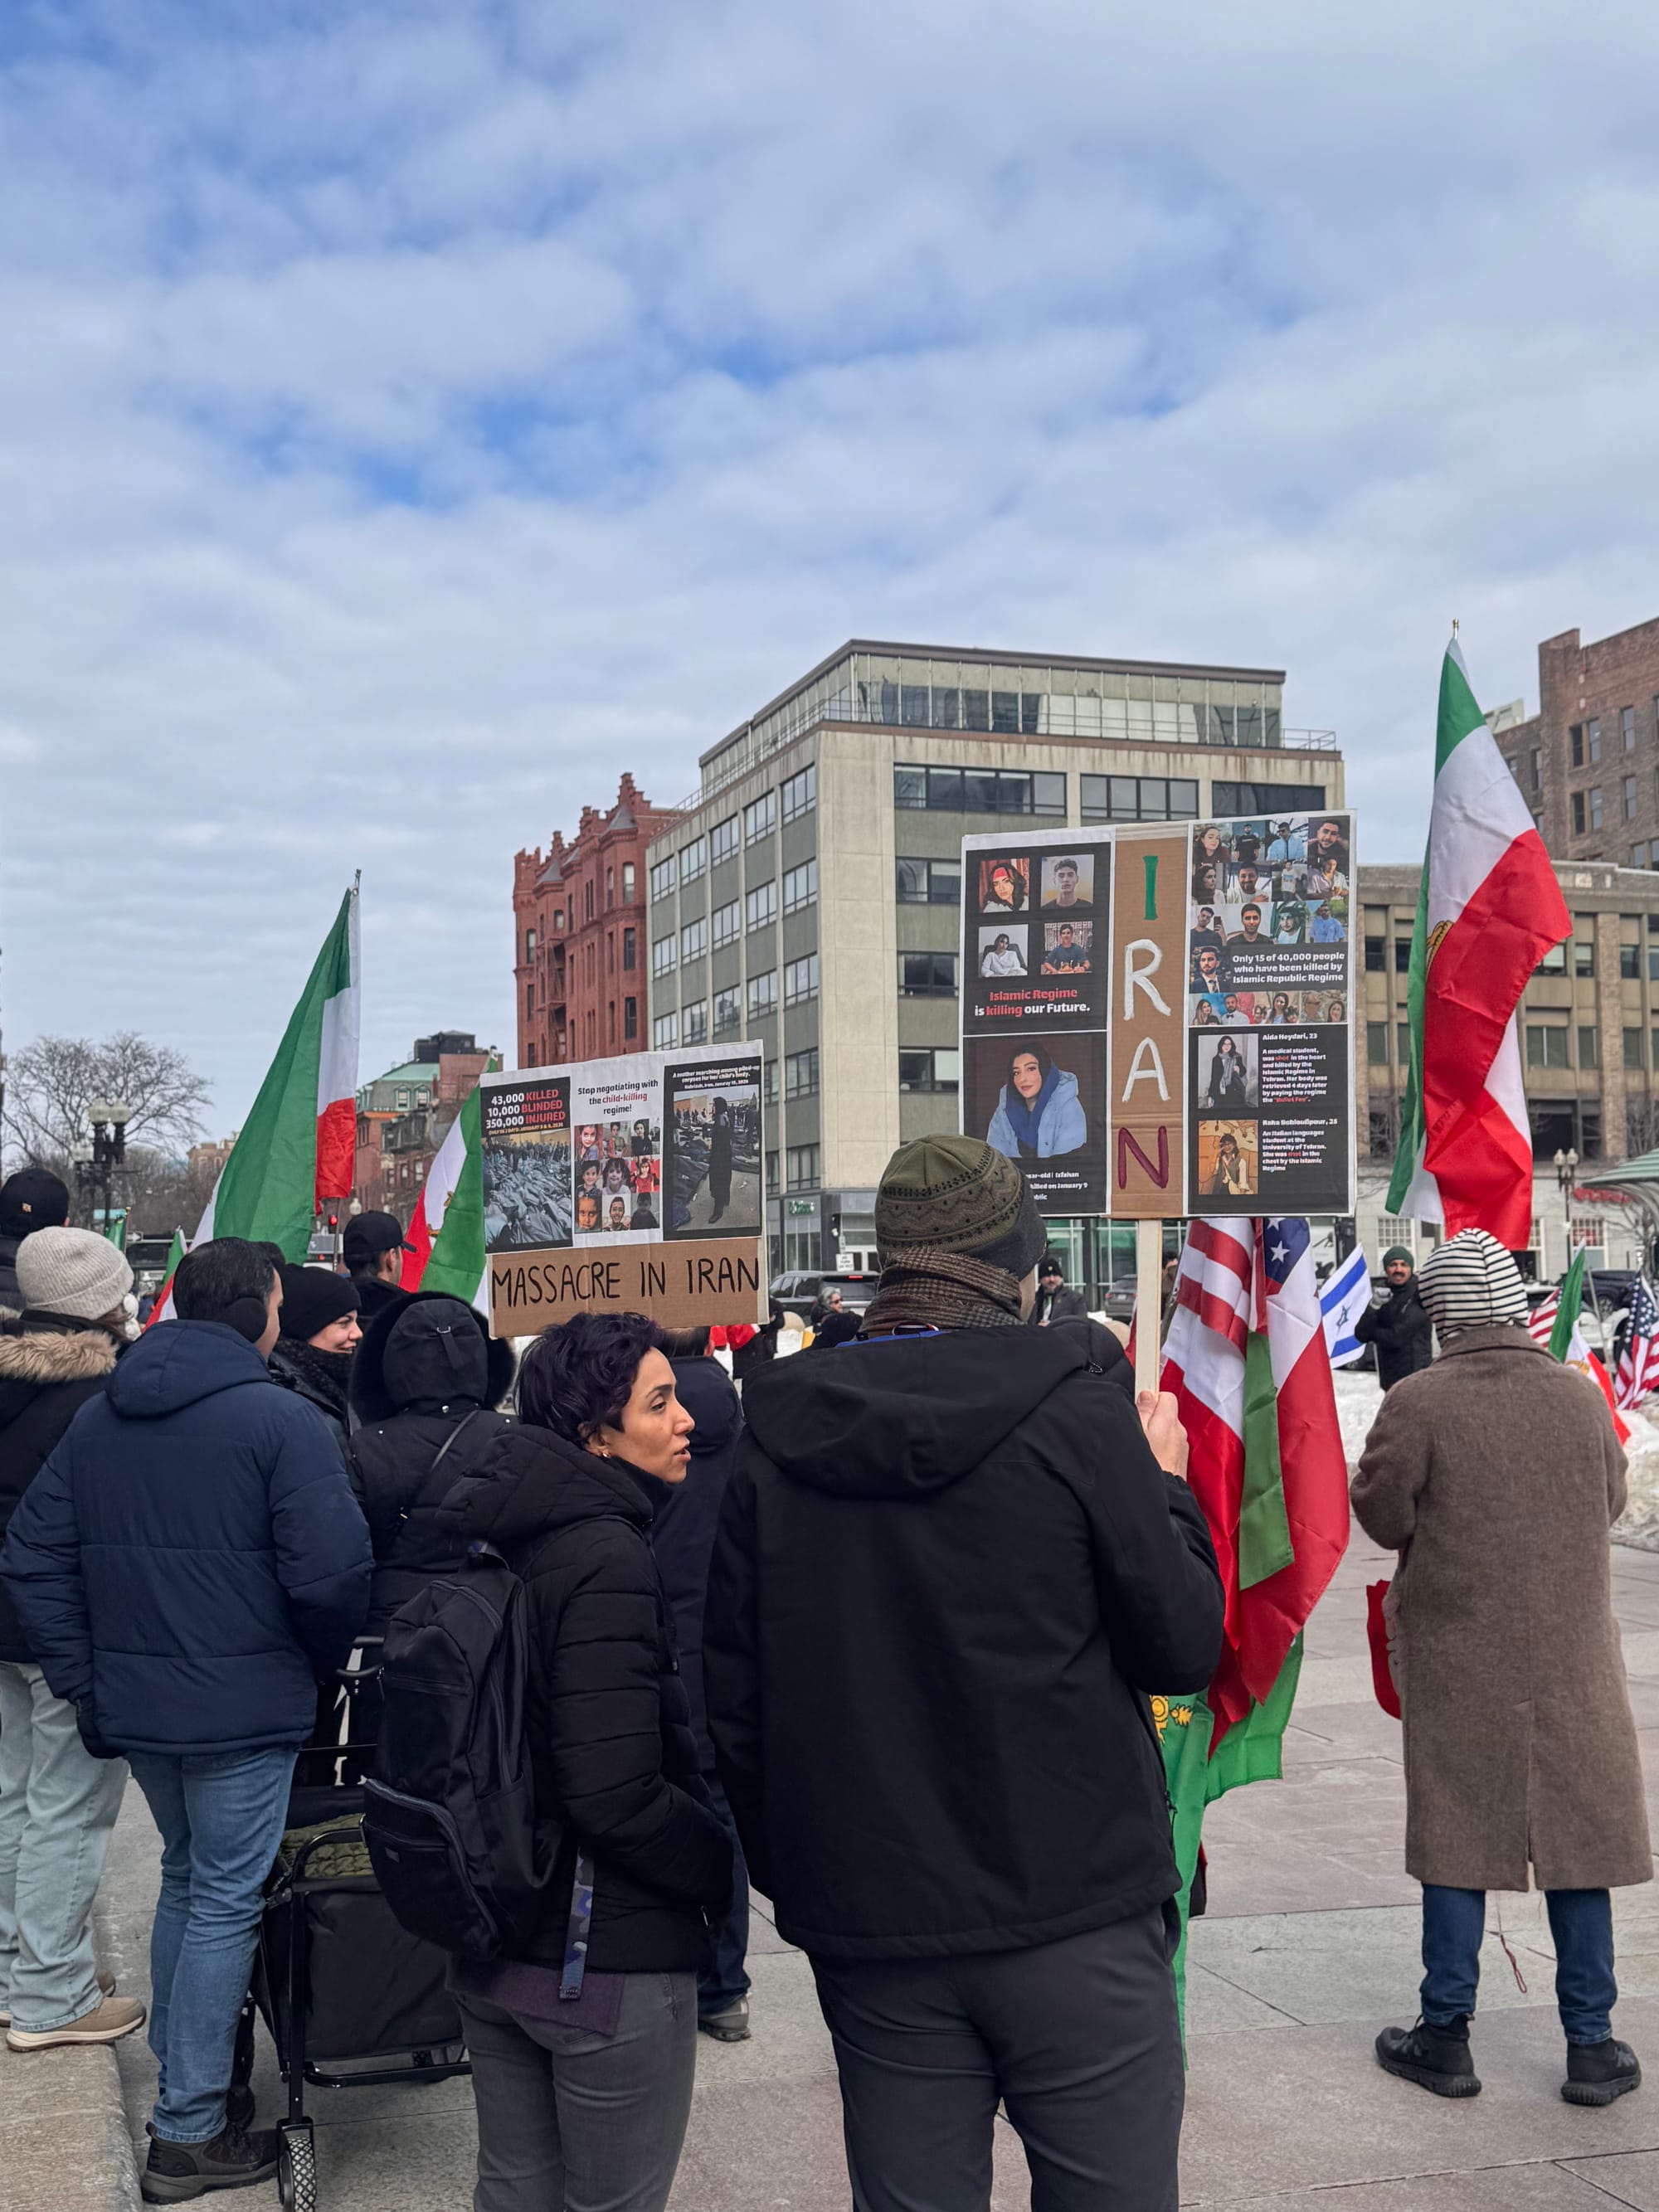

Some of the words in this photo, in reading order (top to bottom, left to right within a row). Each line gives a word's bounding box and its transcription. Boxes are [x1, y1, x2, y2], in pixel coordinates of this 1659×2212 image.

[1233, 955, 1253, 965] Only
[1255, 954, 1265, 962] 15
[1277, 953, 1311, 962] 40,000
[1312, 952, 1345, 961] people
[1255, 965, 1277, 973] have
[1279, 964, 1301, 972] been
[1303, 963, 1329, 971] killed
[1331, 963, 1343, 972] by
[1233, 975, 1266, 984] Islamic
[1267, 973, 1306, 984] Republic
[1308, 973, 1344, 983] Regime
[989, 989, 1031, 1002] Islamic
[1033, 987, 1078, 1001] Regime
[975, 1005, 985, 1016] is
[986, 1004, 1023, 1017] killing
[1024, 1005, 1045, 1014] our
[1047, 1003, 1091, 1014] Future.
[1117, 855, 1171, 1190] IRAN
[1278, 1033, 1308, 1041] Heydari,
[596, 1082, 640, 1094] negotiating
[641, 1079, 658, 1088] with
[491, 1093, 525, 1106] 43,000
[526, 1089, 559, 1101] KILLED
[602, 1092, 648, 1103] child-killing
[488, 1105, 520, 1117] 10,000
[521, 1100, 562, 1113] BLINDED
[604, 1104, 632, 1116] regime!
[485, 1116, 524, 1129] 350,000
[526, 1111, 566, 1124] INJURED
[491, 1262, 620, 1310] MASSACRE
[640, 1262, 665, 1297] IN
[686, 1257, 760, 1294] IRAN
